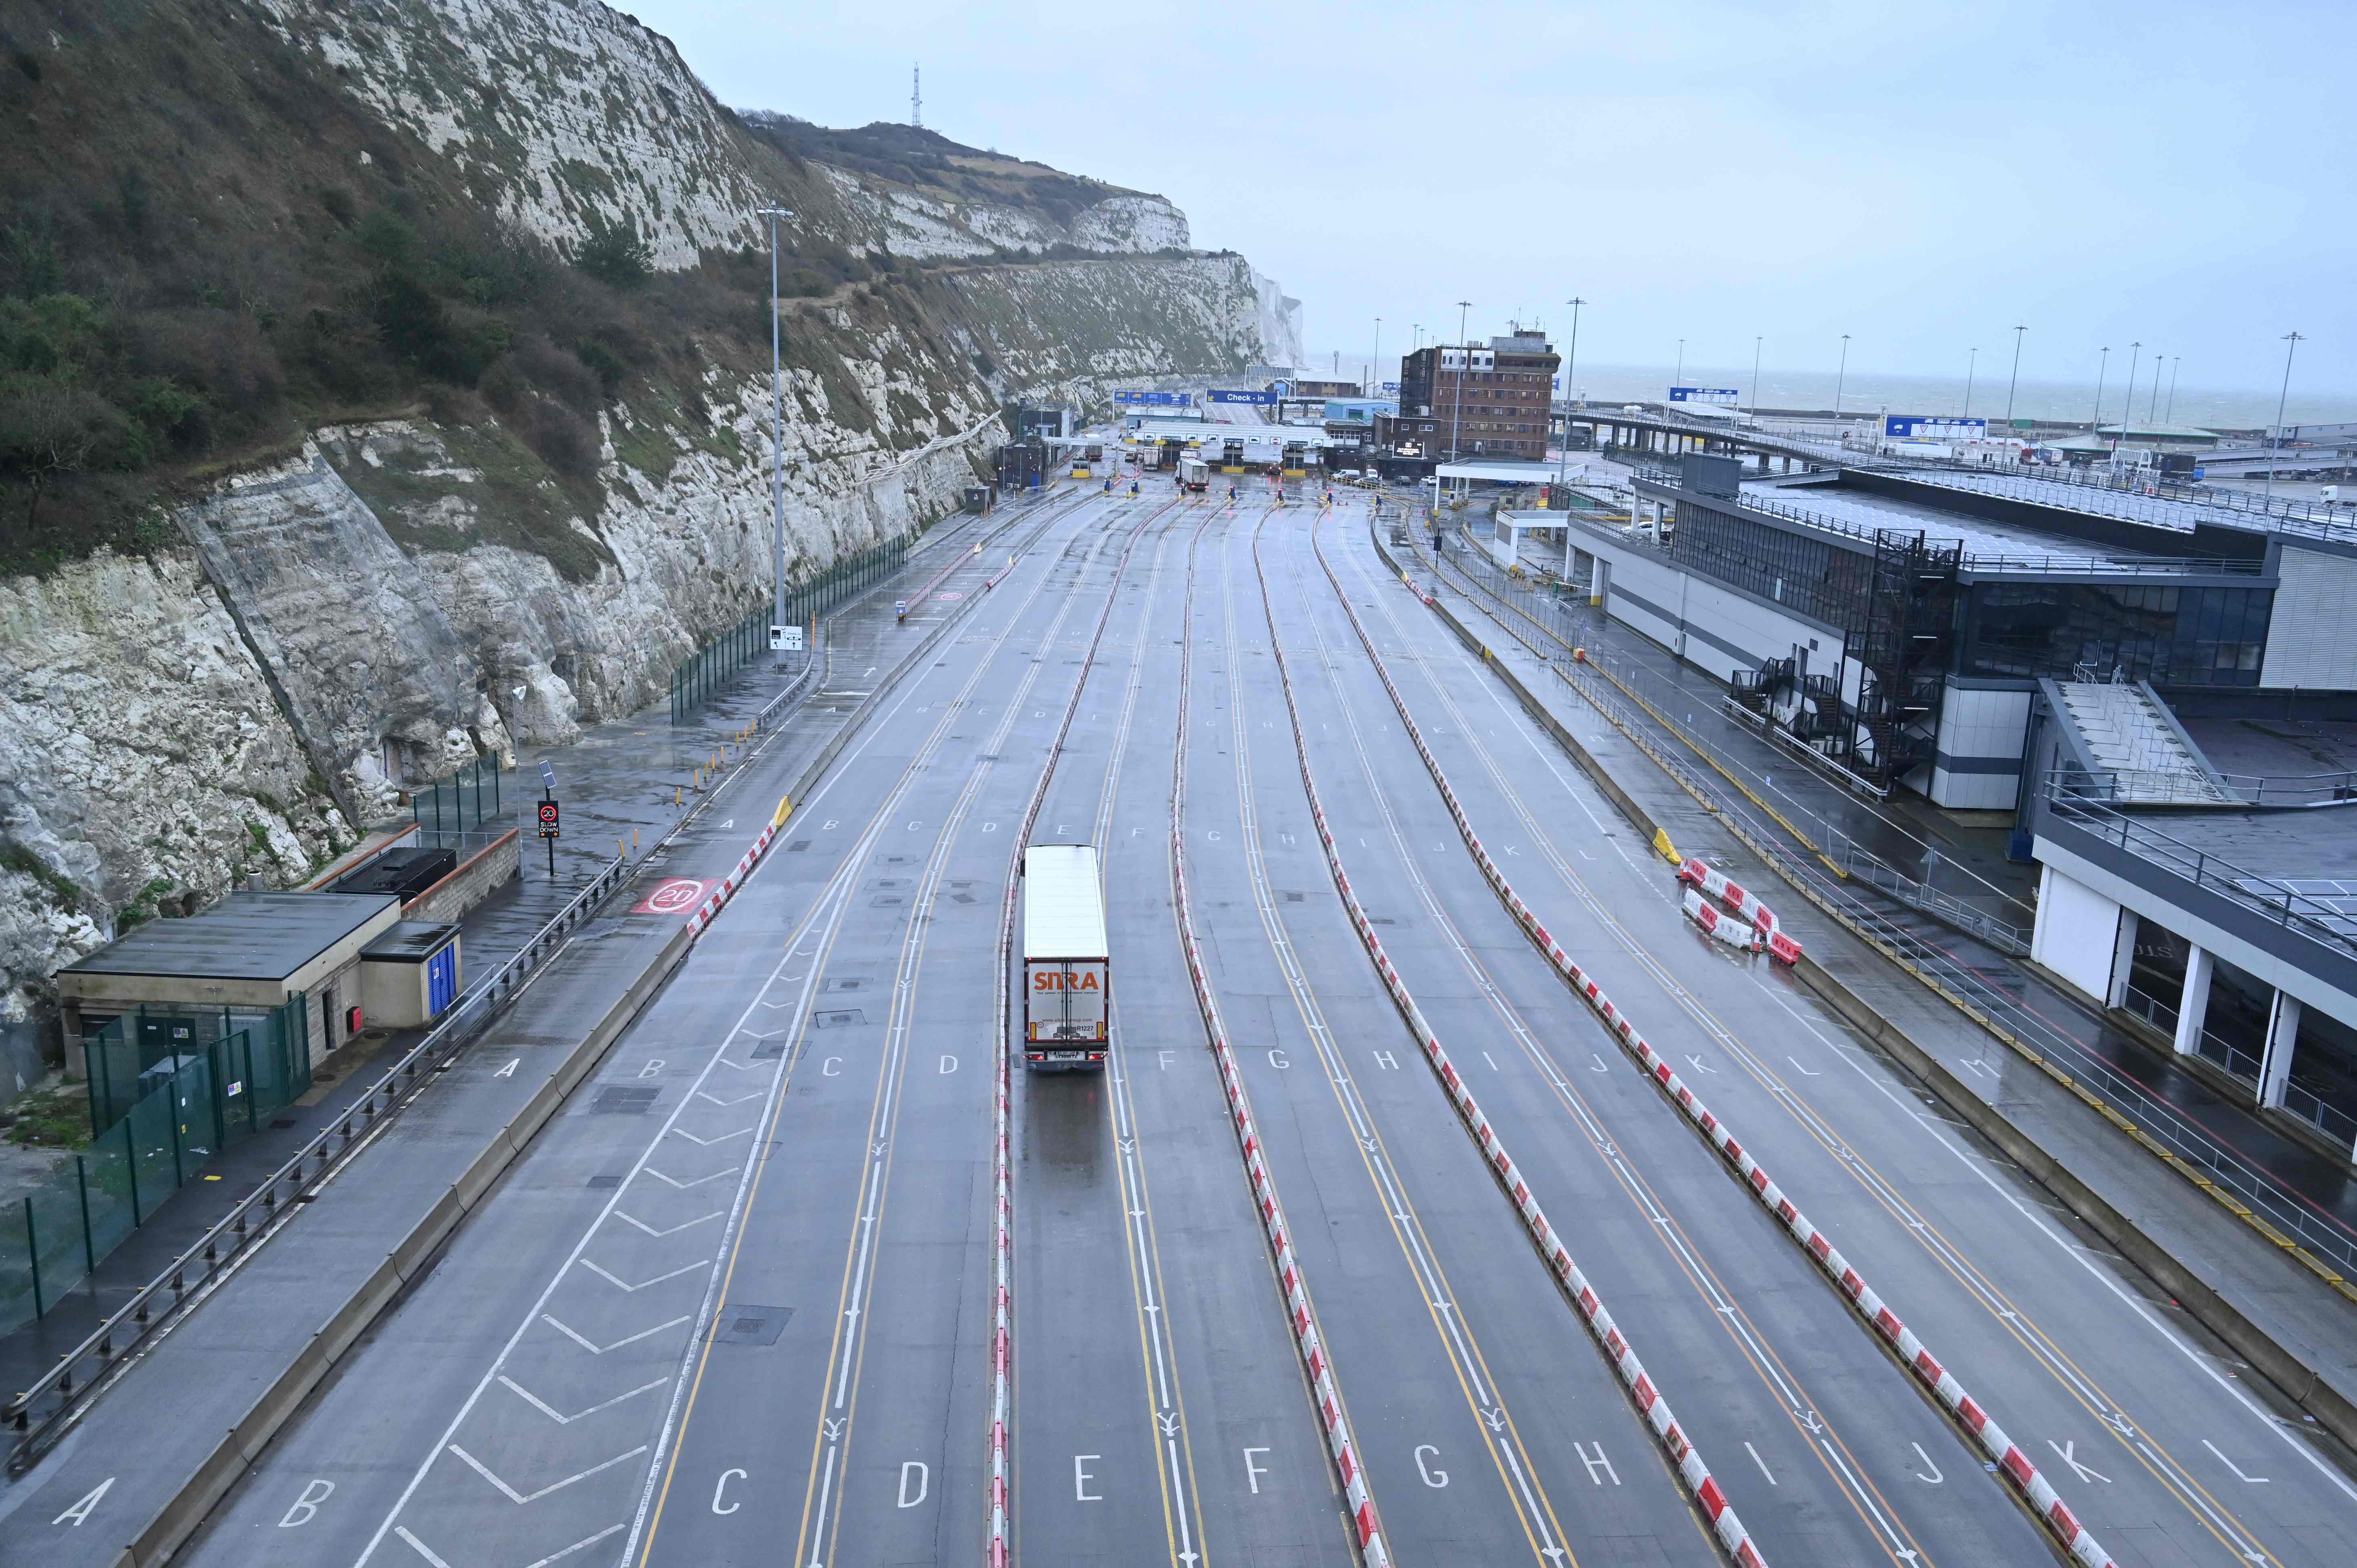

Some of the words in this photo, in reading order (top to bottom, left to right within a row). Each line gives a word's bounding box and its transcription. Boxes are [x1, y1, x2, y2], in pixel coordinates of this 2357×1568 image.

[719, 819, 733, 828] A
[822, 820, 839, 830] B
[907, 821, 922, 830] C
[982, 822, 997, 832] D
[1057, 825, 1072, 835] E
[1132, 828, 1145, 837] F
[1208, 831, 1220, 840] G
[1281, 834, 1295, 844] H
[1433, 842, 1445, 851] J
[1504, 845, 1521, 855] K
[1579, 850, 1597, 860] L
[655, 890, 693, 902] 20
[1034, 972, 1099, 990] SITRA
[493, 1058, 520, 1077] A
[638, 1059, 666, 1078] B
[822, 1057, 843, 1076] C
[939, 1055, 958, 1074] D
[1160, 1051, 1175, 1070] F
[1268, 1050, 1289, 1069] G
[1373, 1051, 1399, 1070] H
[1590, 1054, 1608, 1072] J
[1684, 1055, 1718, 1073] K
[1787, 1056, 1820, 1075] L
[1959, 1059, 2001, 1078] M
[1414, 1445, 1449, 1488] G
[1573, 1441, 1621, 1485] H
[1911, 1442, 1944, 1483] J
[2047, 1440, 2112, 1483] K
[2202, 1439, 2270, 1482] L
[1075, 1455, 1103, 1501] E
[1243, 1447, 1270, 1494] F
[712, 1468, 747, 1514] C
[897, 1462, 928, 1508] D
[51, 1477, 115, 1526] A
[278, 1479, 335, 1527] B
